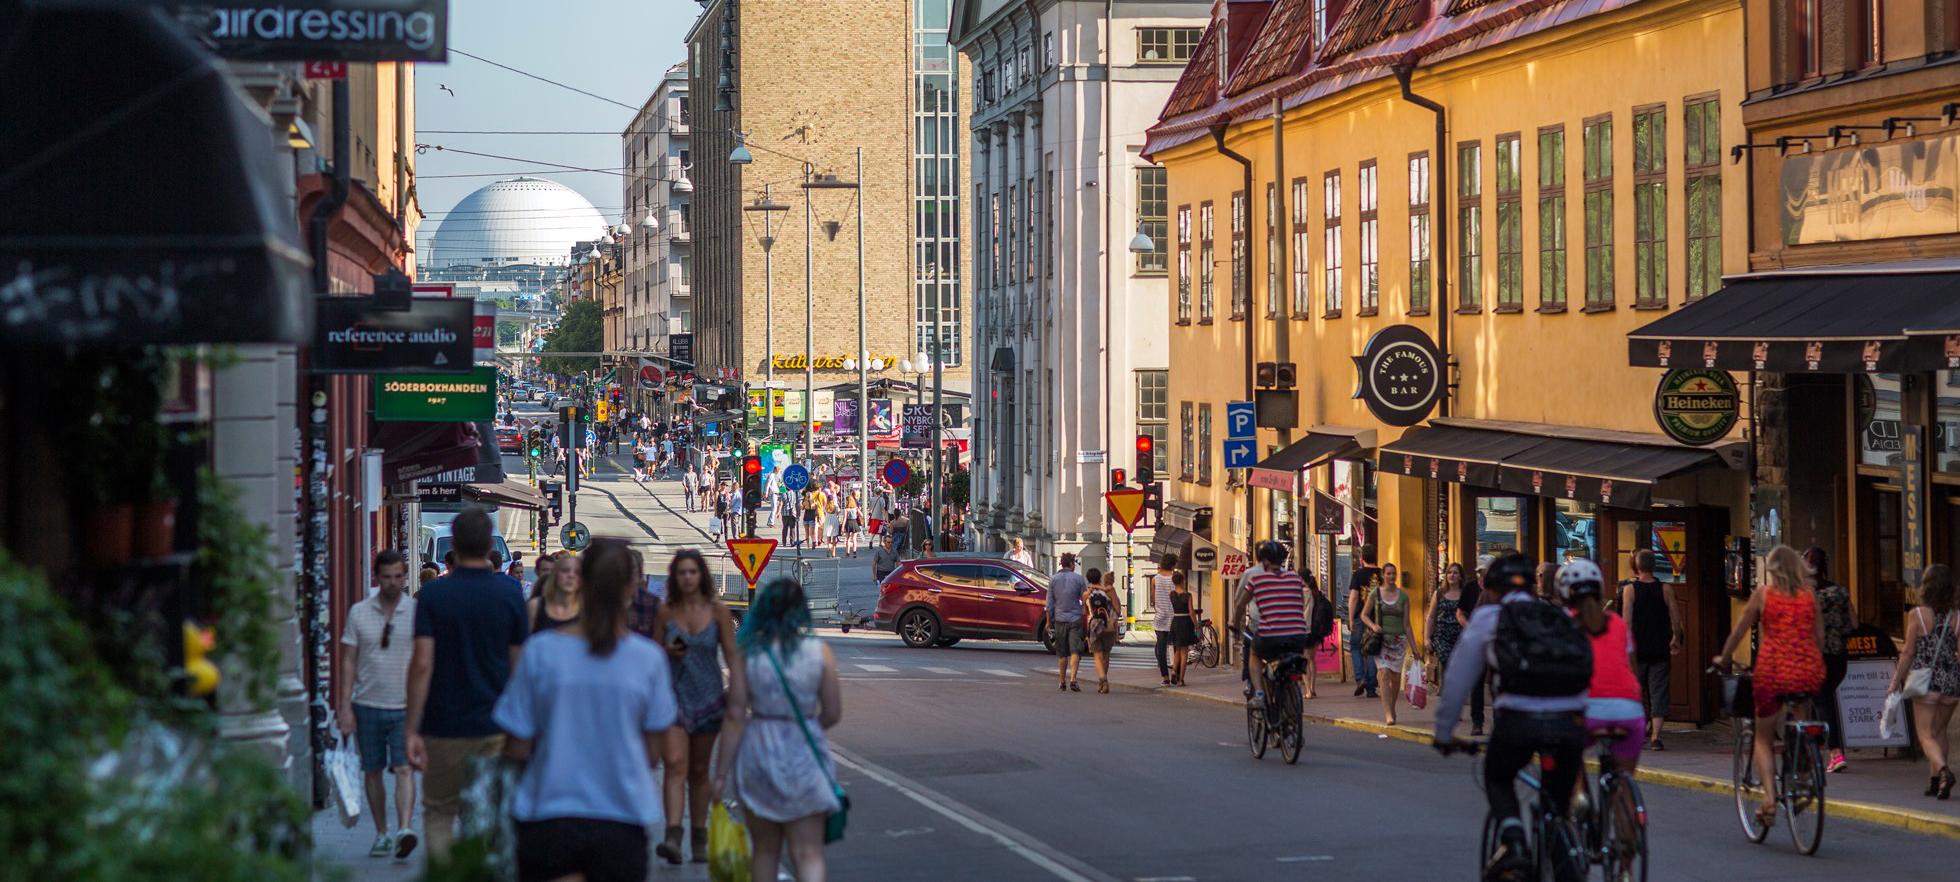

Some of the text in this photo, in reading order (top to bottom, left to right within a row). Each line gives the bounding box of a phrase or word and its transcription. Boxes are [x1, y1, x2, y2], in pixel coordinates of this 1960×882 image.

[328, 327, 457, 344] reference audio
[1380, 350, 1429, 375] THE FAMOUS
[384, 381, 488, 393] SÖDERBOKHANDELN
[1391, 387, 1418, 395] BAR
[834, 400, 858, 412] NILS
[1667, 396, 1732, 409] Heineken
[1236, 415, 1249, 433] P
[437, 466, 476, 482] VINTAGE
[431, 487, 439, 495] &
[439, 487, 457, 495] herr
[1905, 433, 1917, 549] MEST
[1225, 554, 1243, 564] REA
[1221, 564, 1247, 576] REA
[1847, 636, 1878, 651] MEST
[1867, 671, 1878, 680] till
[1880, 672, 1891, 680] 21
[1849, 707, 1872, 717] STOR
[1848, 714, 1876, 724] STARK
